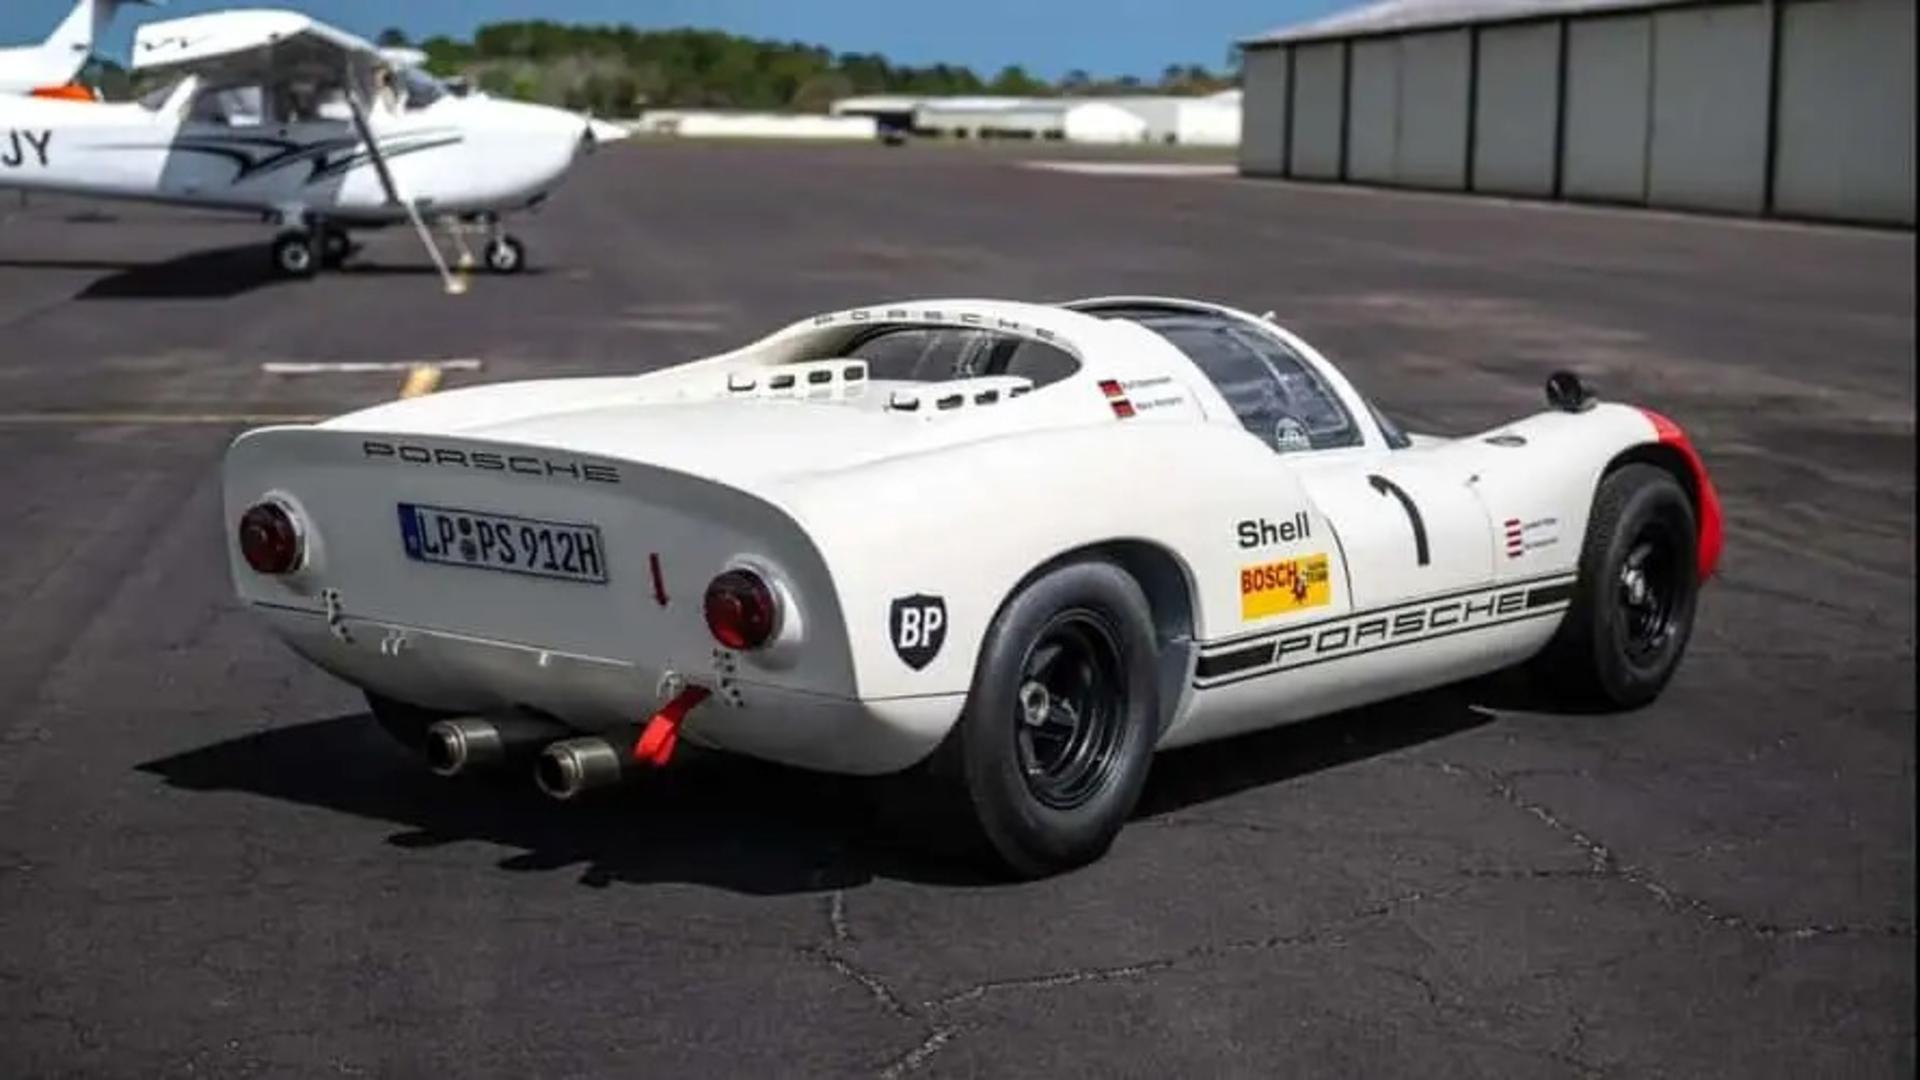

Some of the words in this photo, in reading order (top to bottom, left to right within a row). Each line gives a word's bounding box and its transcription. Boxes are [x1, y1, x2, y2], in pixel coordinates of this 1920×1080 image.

[363, 441, 621, 483] PORSCHE
[519, 527, 600, 575] 912H
[1237, 511, 1311, 549] Shell
[1241, 560, 1297, 595] BOSCH
[899, 606, 943, 648] BP
[1274, 588, 1529, 662] PORSCHE
